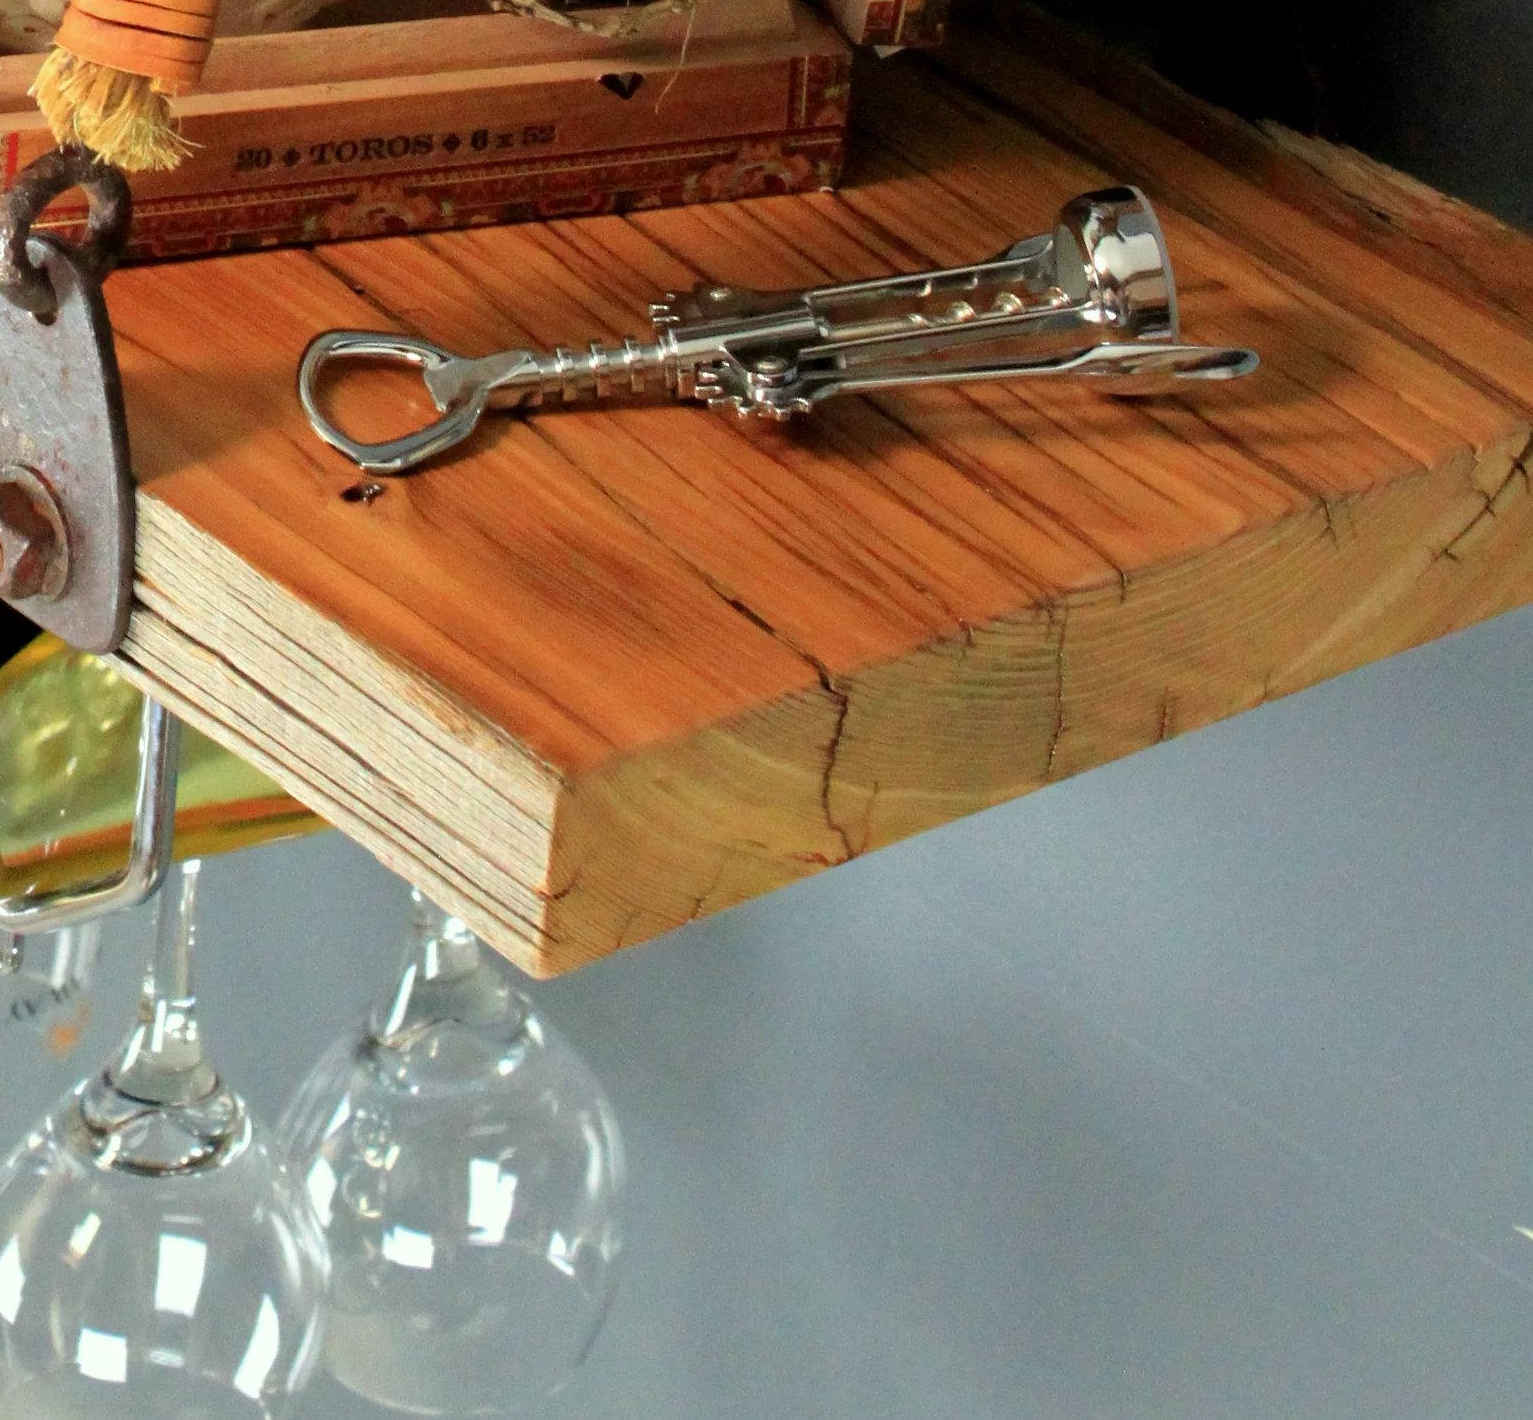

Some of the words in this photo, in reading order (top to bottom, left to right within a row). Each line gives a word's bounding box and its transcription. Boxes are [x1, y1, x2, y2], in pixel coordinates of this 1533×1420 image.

[236, 147, 272, 171] 20
[309, 133, 434, 165] TOROS
[522, 124, 556, 147] 52
